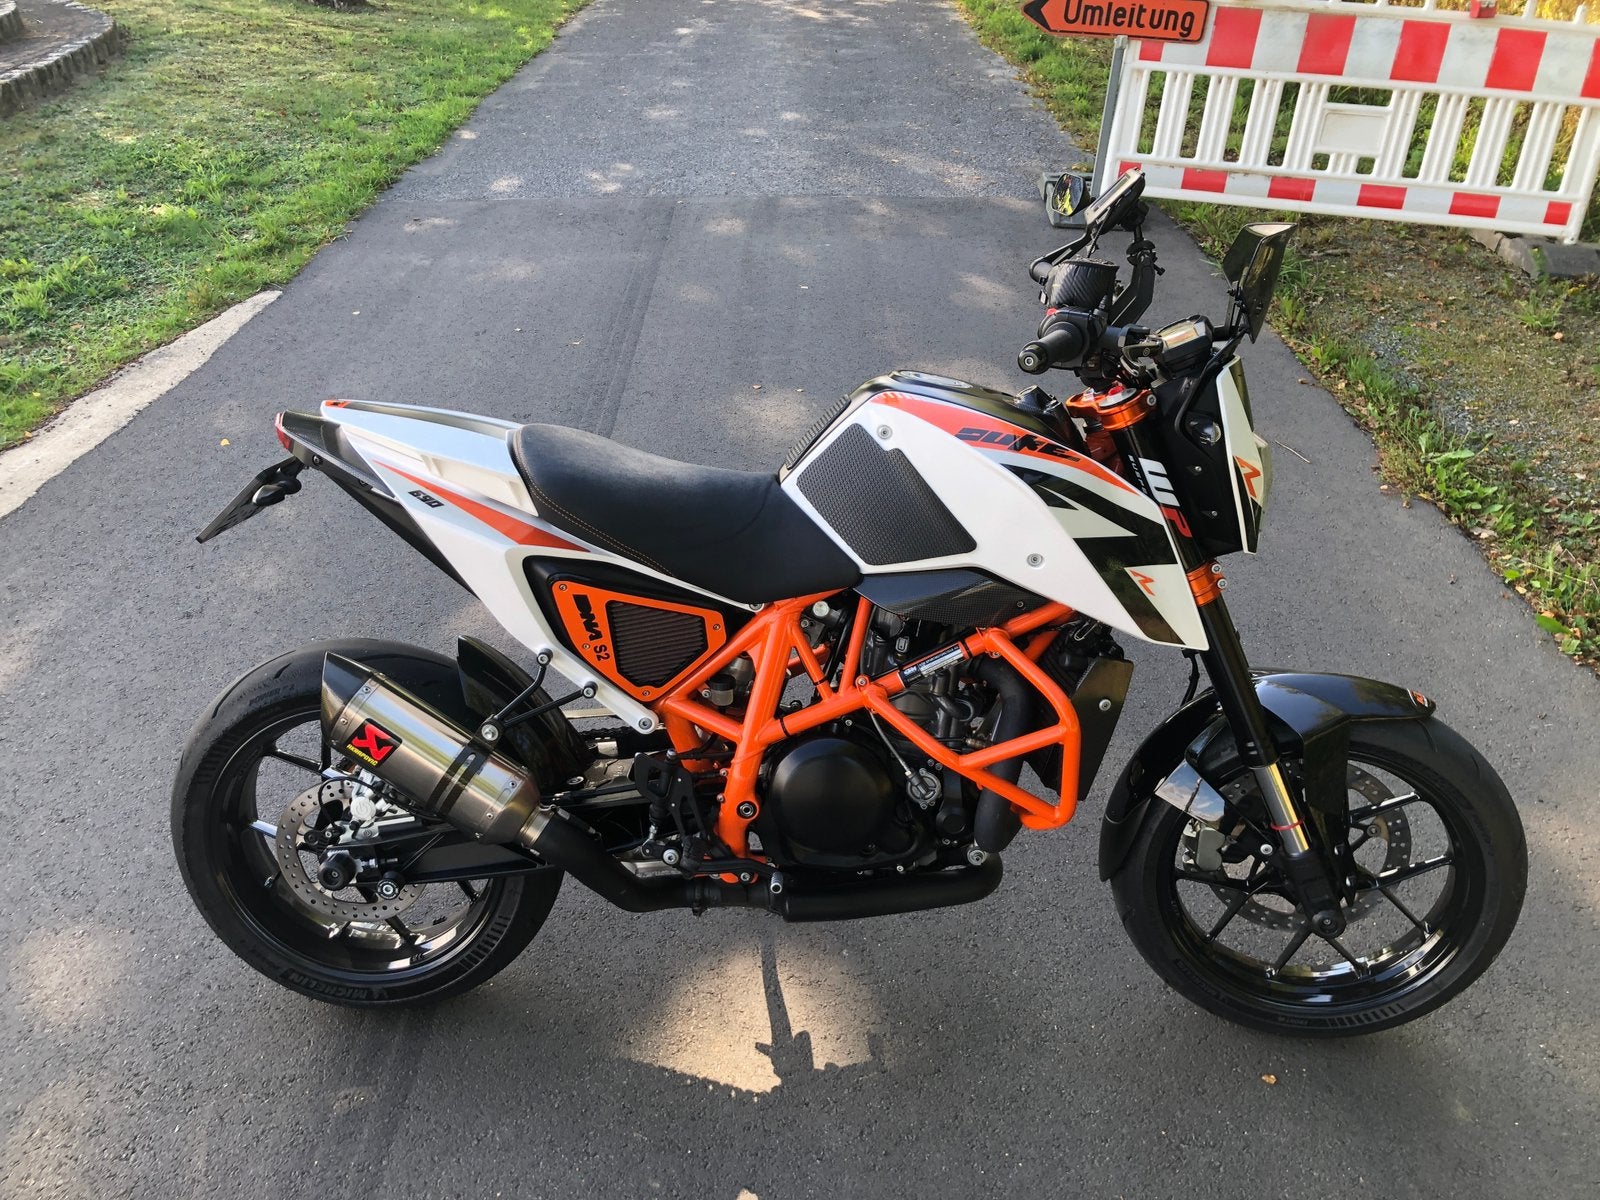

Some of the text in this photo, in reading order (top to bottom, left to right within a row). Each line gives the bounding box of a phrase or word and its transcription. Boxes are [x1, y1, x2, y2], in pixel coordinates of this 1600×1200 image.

[1063, 0, 1195, 38] Umleitung
[954, 427, 1080, 462] DUKE
[408, 490, 445, 508] 690
[1138, 457, 1193, 538] WP
[572, 594, 611, 661] DNA S2
[288, 971, 368, 999] MICHELIN
